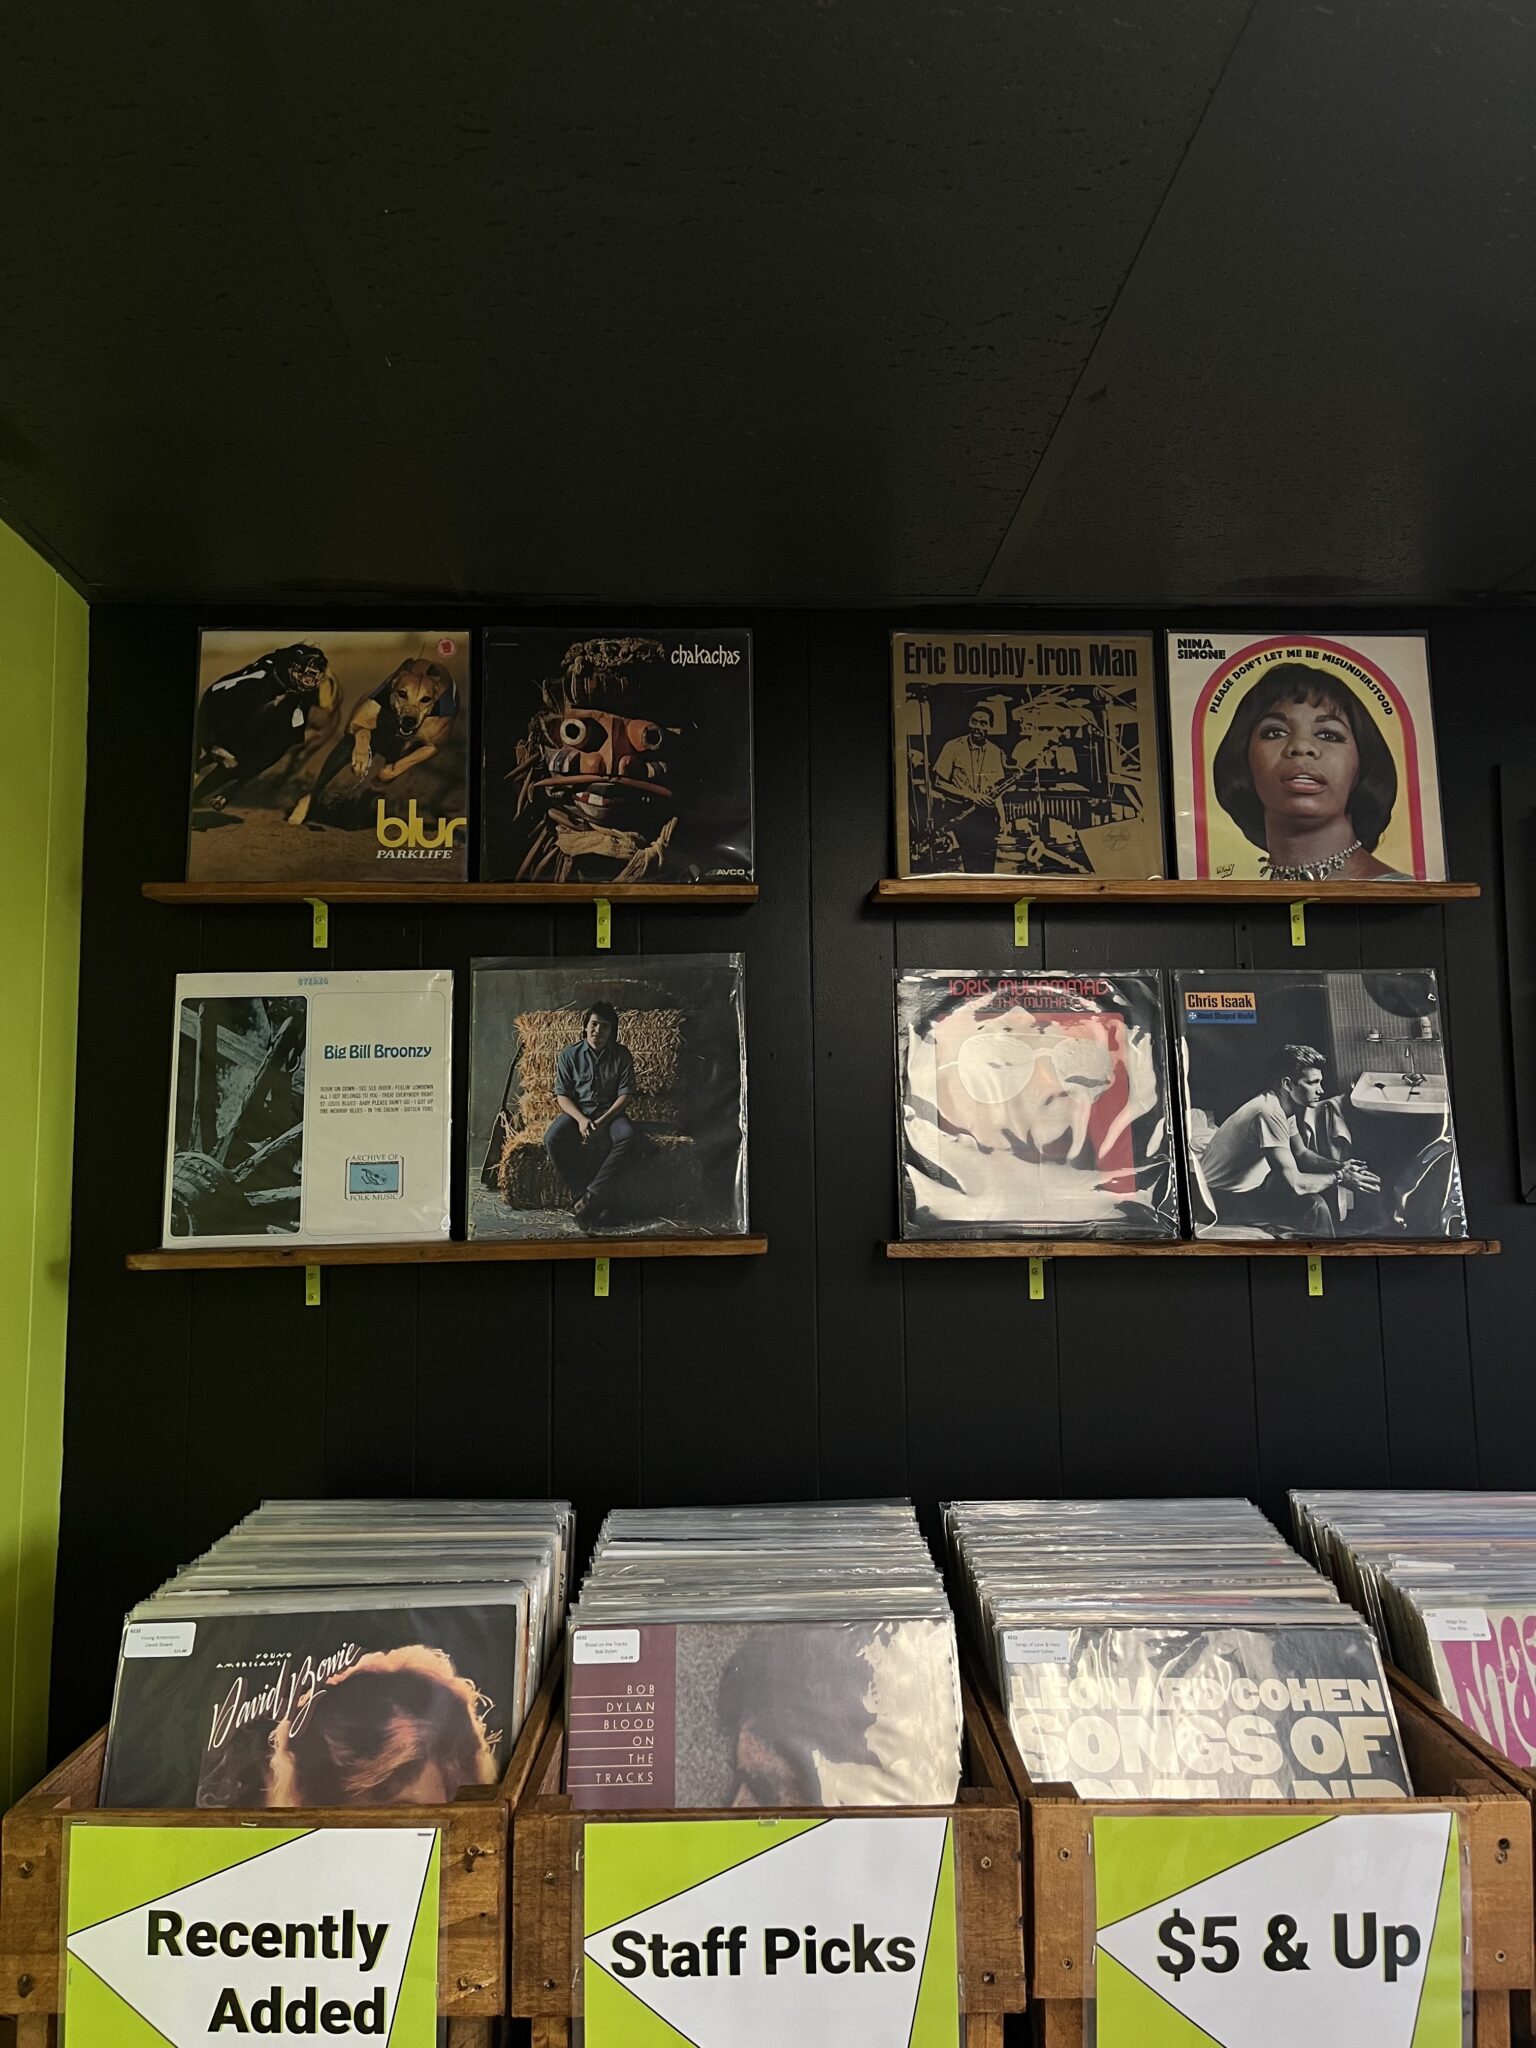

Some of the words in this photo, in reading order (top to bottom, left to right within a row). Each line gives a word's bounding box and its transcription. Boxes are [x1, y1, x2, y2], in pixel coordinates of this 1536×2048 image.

[1177, 638, 1213, 649] NINA
[671, 644, 741, 667] chakachas
[904, 642, 946, 674] Eric
[1089, 644, 1138, 676] Man
[1177, 650, 1226, 659] SIMONE
[1209, 678, 1234, 714] PLEASE
[1232, 657, 1262, 680] DON'T
[1264, 651, 1283, 662] LET
[1287, 649, 1302, 657] ME
[1306, 650, 1319, 659] BE
[1322, 653, 1393, 715] MISUNDERSTOOD
[377, 799, 467, 848] blur
[376, 850, 453, 859] PARKLIFE
[950, 979, 991, 996] IDRIS
[997, 978, 1109, 996] MUHAMMAD
[1188, 994, 1217, 1008] Chris
[1221, 994, 1253, 1008] Isaak
[324, 1045, 347, 1059] Big
[349, 1044, 371, 1058] Bill
[374, 1044, 432, 1059] Broonzy
[216, 1661, 281, 1669] AMERICANS
[207, 1659, 288, 1751] David
[286, 1642, 361, 1738] Bowie
[627, 1684, 655, 1694] BOB
[1012, 1676, 1226, 1711] LEONARD
[1230, 1678, 1385, 1712] COHEN
[606, 1702, 655, 1712] DYLAN
[604, 1719, 654, 1729] BLOOD
[632, 1736, 654, 1746] ON
[1015, 1714, 1284, 1775] SONGS
[1290, 1716, 1391, 1774] OF
[628, 1753, 653, 1763] THE
[596, 1772, 653, 1783] TRACKS
[147, 1909, 389, 1972] Recently
[1157, 1908, 1240, 1982] $5
[1263, 1914, 1312, 1971] &
[1333, 1912, 1421, 1982] Up
[611, 1925, 747, 1978] Staff
[764, 1923, 916, 1975] Picks
[207, 1986, 386, 2035] Added
